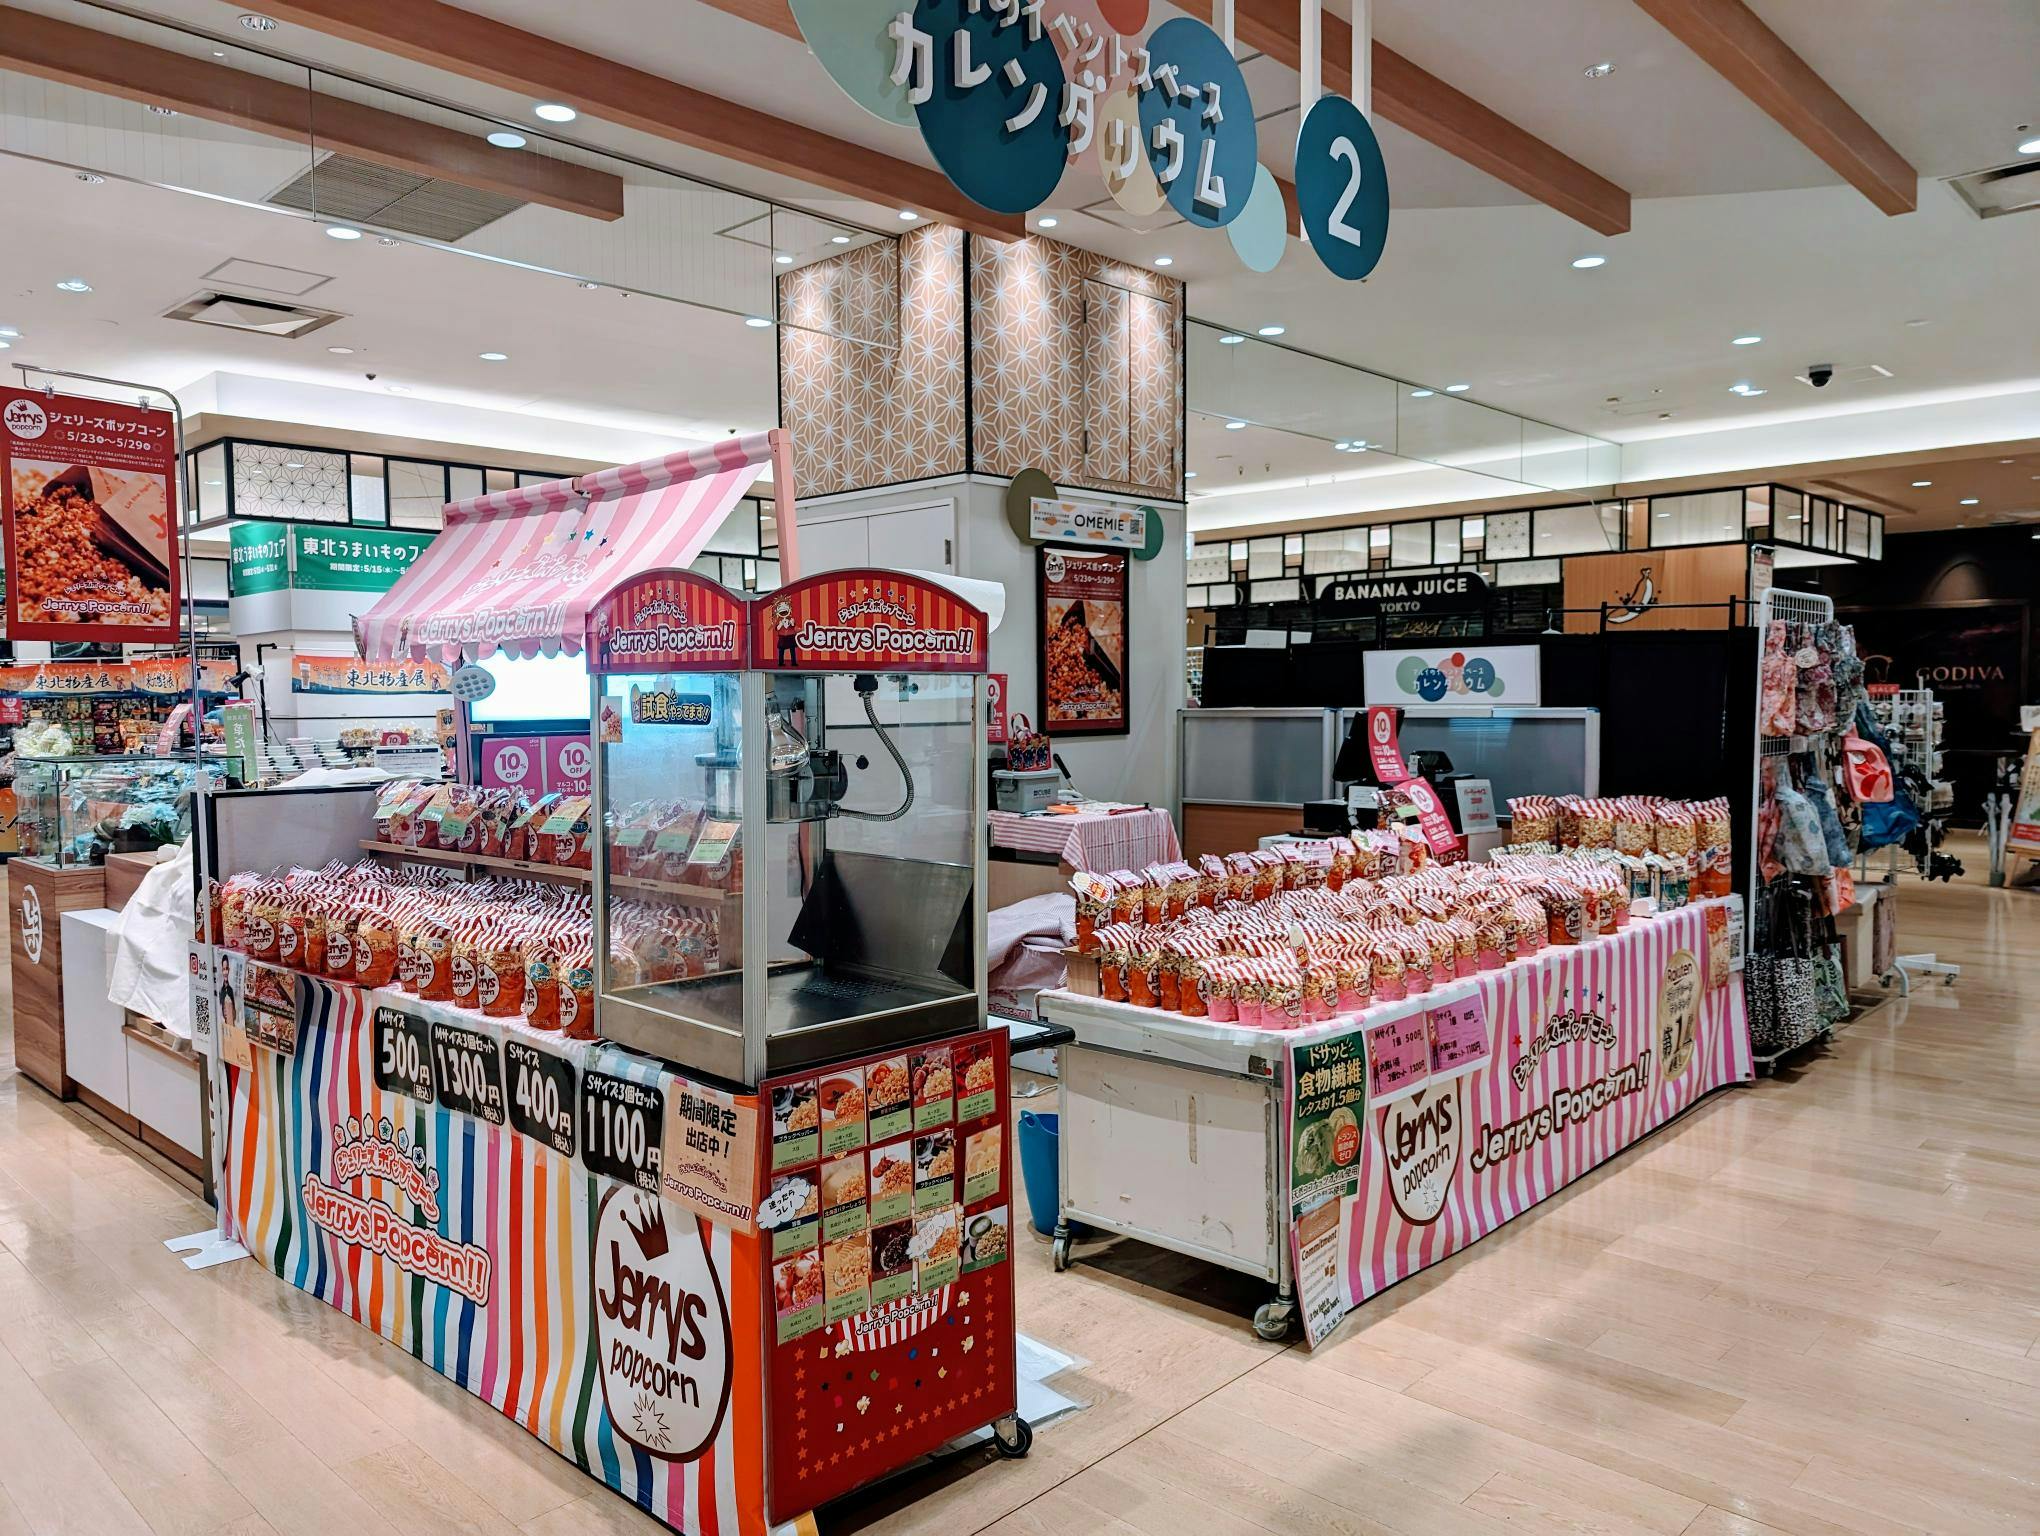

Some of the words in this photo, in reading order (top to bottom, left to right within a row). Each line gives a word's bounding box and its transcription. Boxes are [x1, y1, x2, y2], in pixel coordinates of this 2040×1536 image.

[888, 11, 1227, 209] カレンダリウム
[1327, 136, 1364, 248] 2
[6, 410, 43, 425] Jerrys
[11, 423, 42, 432] popcorn
[49, 411, 167, 438] ジェリーズポップコーン
[1074, 514, 1124, 532] OMEMIE
[1334, 580, 1408, 601] BANANA
[1412, 577, 1468, 596] JUICE
[42, 598, 87, 616] Jerrys
[88, 600, 150, 614] Popcorn!!
[419, 614, 474, 643] Jerrys
[474, 602, 564, 641] Popcorn!!
[1379, 600, 1421, 613] TOKYO
[609, 625, 656, 654] Jerrys
[657, 620, 736, 652] Popcorn!!
[798, 623, 873, 653] Jerrys
[873, 624, 977, 655] Popcorn!!
[35, 672, 113, 690] 東北物産展
[346, 669, 427, 688] 東北物産展
[1915, 666, 2005, 682] GODIVA
[505, 771, 520, 779] OFF
[1666, 963, 1693, 983] Rakuten
[379, 1009, 406, 1029] Mサイズ
[382, 1027, 431, 1086] 500円
[435, 1026, 496, 1055] Mサイズ3個セット
[509, 1043, 540, 1069] Sサイズ
[1309, 1042, 1349, 1068] ドサッと
[437, 1043, 501, 1107] 1300円
[1298, 1057, 1363, 1101] 食物繊維
[516, 1064, 572, 1137] 400円
[587, 1074, 659, 1110] Sサイズ3個セット
[1298, 1087, 1362, 1118] レタス約1.5個分
[679, 1091, 738, 1137] 期間限定
[1471, 1105, 1552, 1174] Jerrys
[1552, 1049, 1651, 1134] Popcorn!!
[587, 1095, 662, 1173] 1100円
[685, 1126, 730, 1158] 出店中！
[1337, 1130, 1357, 1142] トランス
[1390, 1091, 1452, 1171] Jerrys
[1339, 1149, 1352, 1160] ゼロ
[1402, 1142, 1451, 1200] popcorn
[664, 1173, 694, 1198] Jerrys
[694, 1186, 752, 1221] Popcorn!!
[303, 1179, 372, 1246] Jerrys
[371, 1204, 490, 1299] Popcorn!!
[1301, 1229, 1338, 1262] Commitment
[599, 1240, 708, 1366] Jerrys
[855, 1317, 891, 1337] Jerrys
[610, 1337, 701, 1408] popcorn
